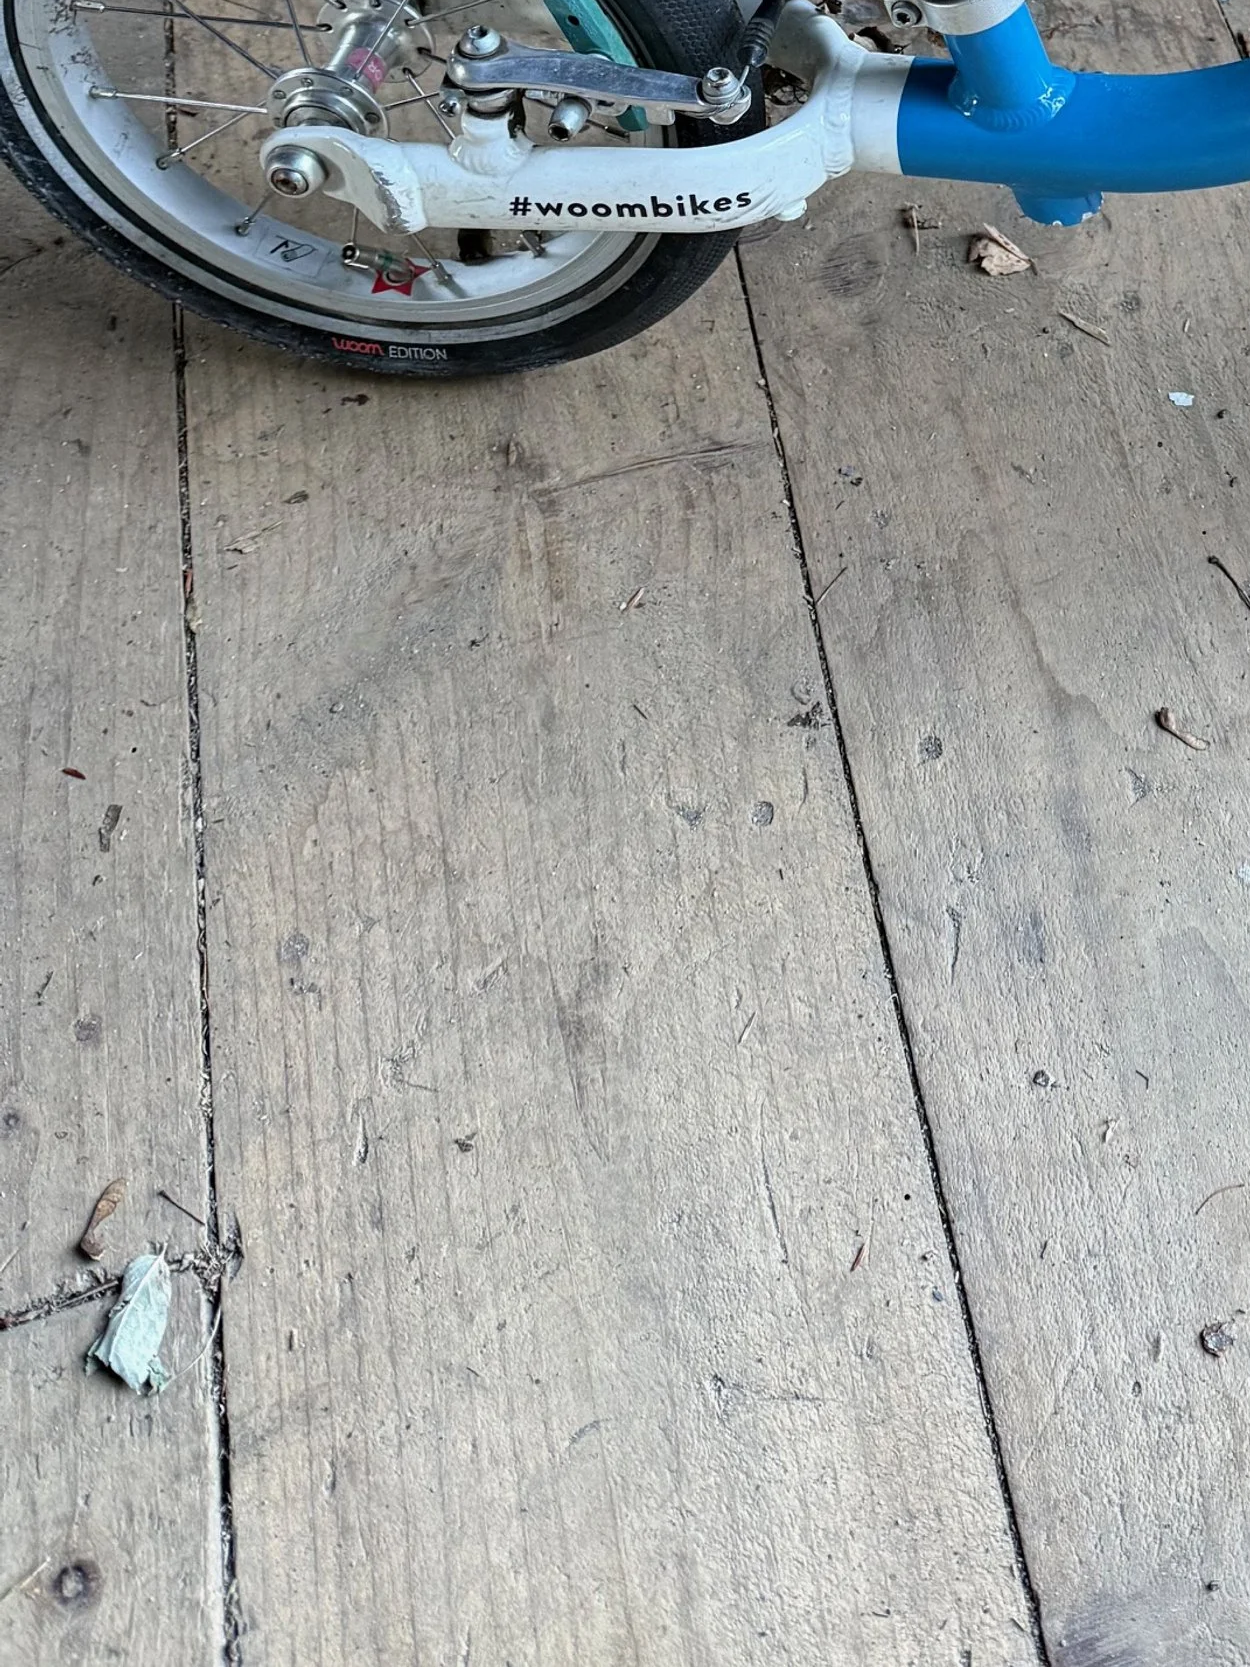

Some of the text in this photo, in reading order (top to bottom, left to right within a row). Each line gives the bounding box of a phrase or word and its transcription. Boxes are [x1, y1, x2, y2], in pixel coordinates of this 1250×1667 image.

[508, 191, 752, 218] #woombikes
[331, 337, 448, 361] woom EDITION
